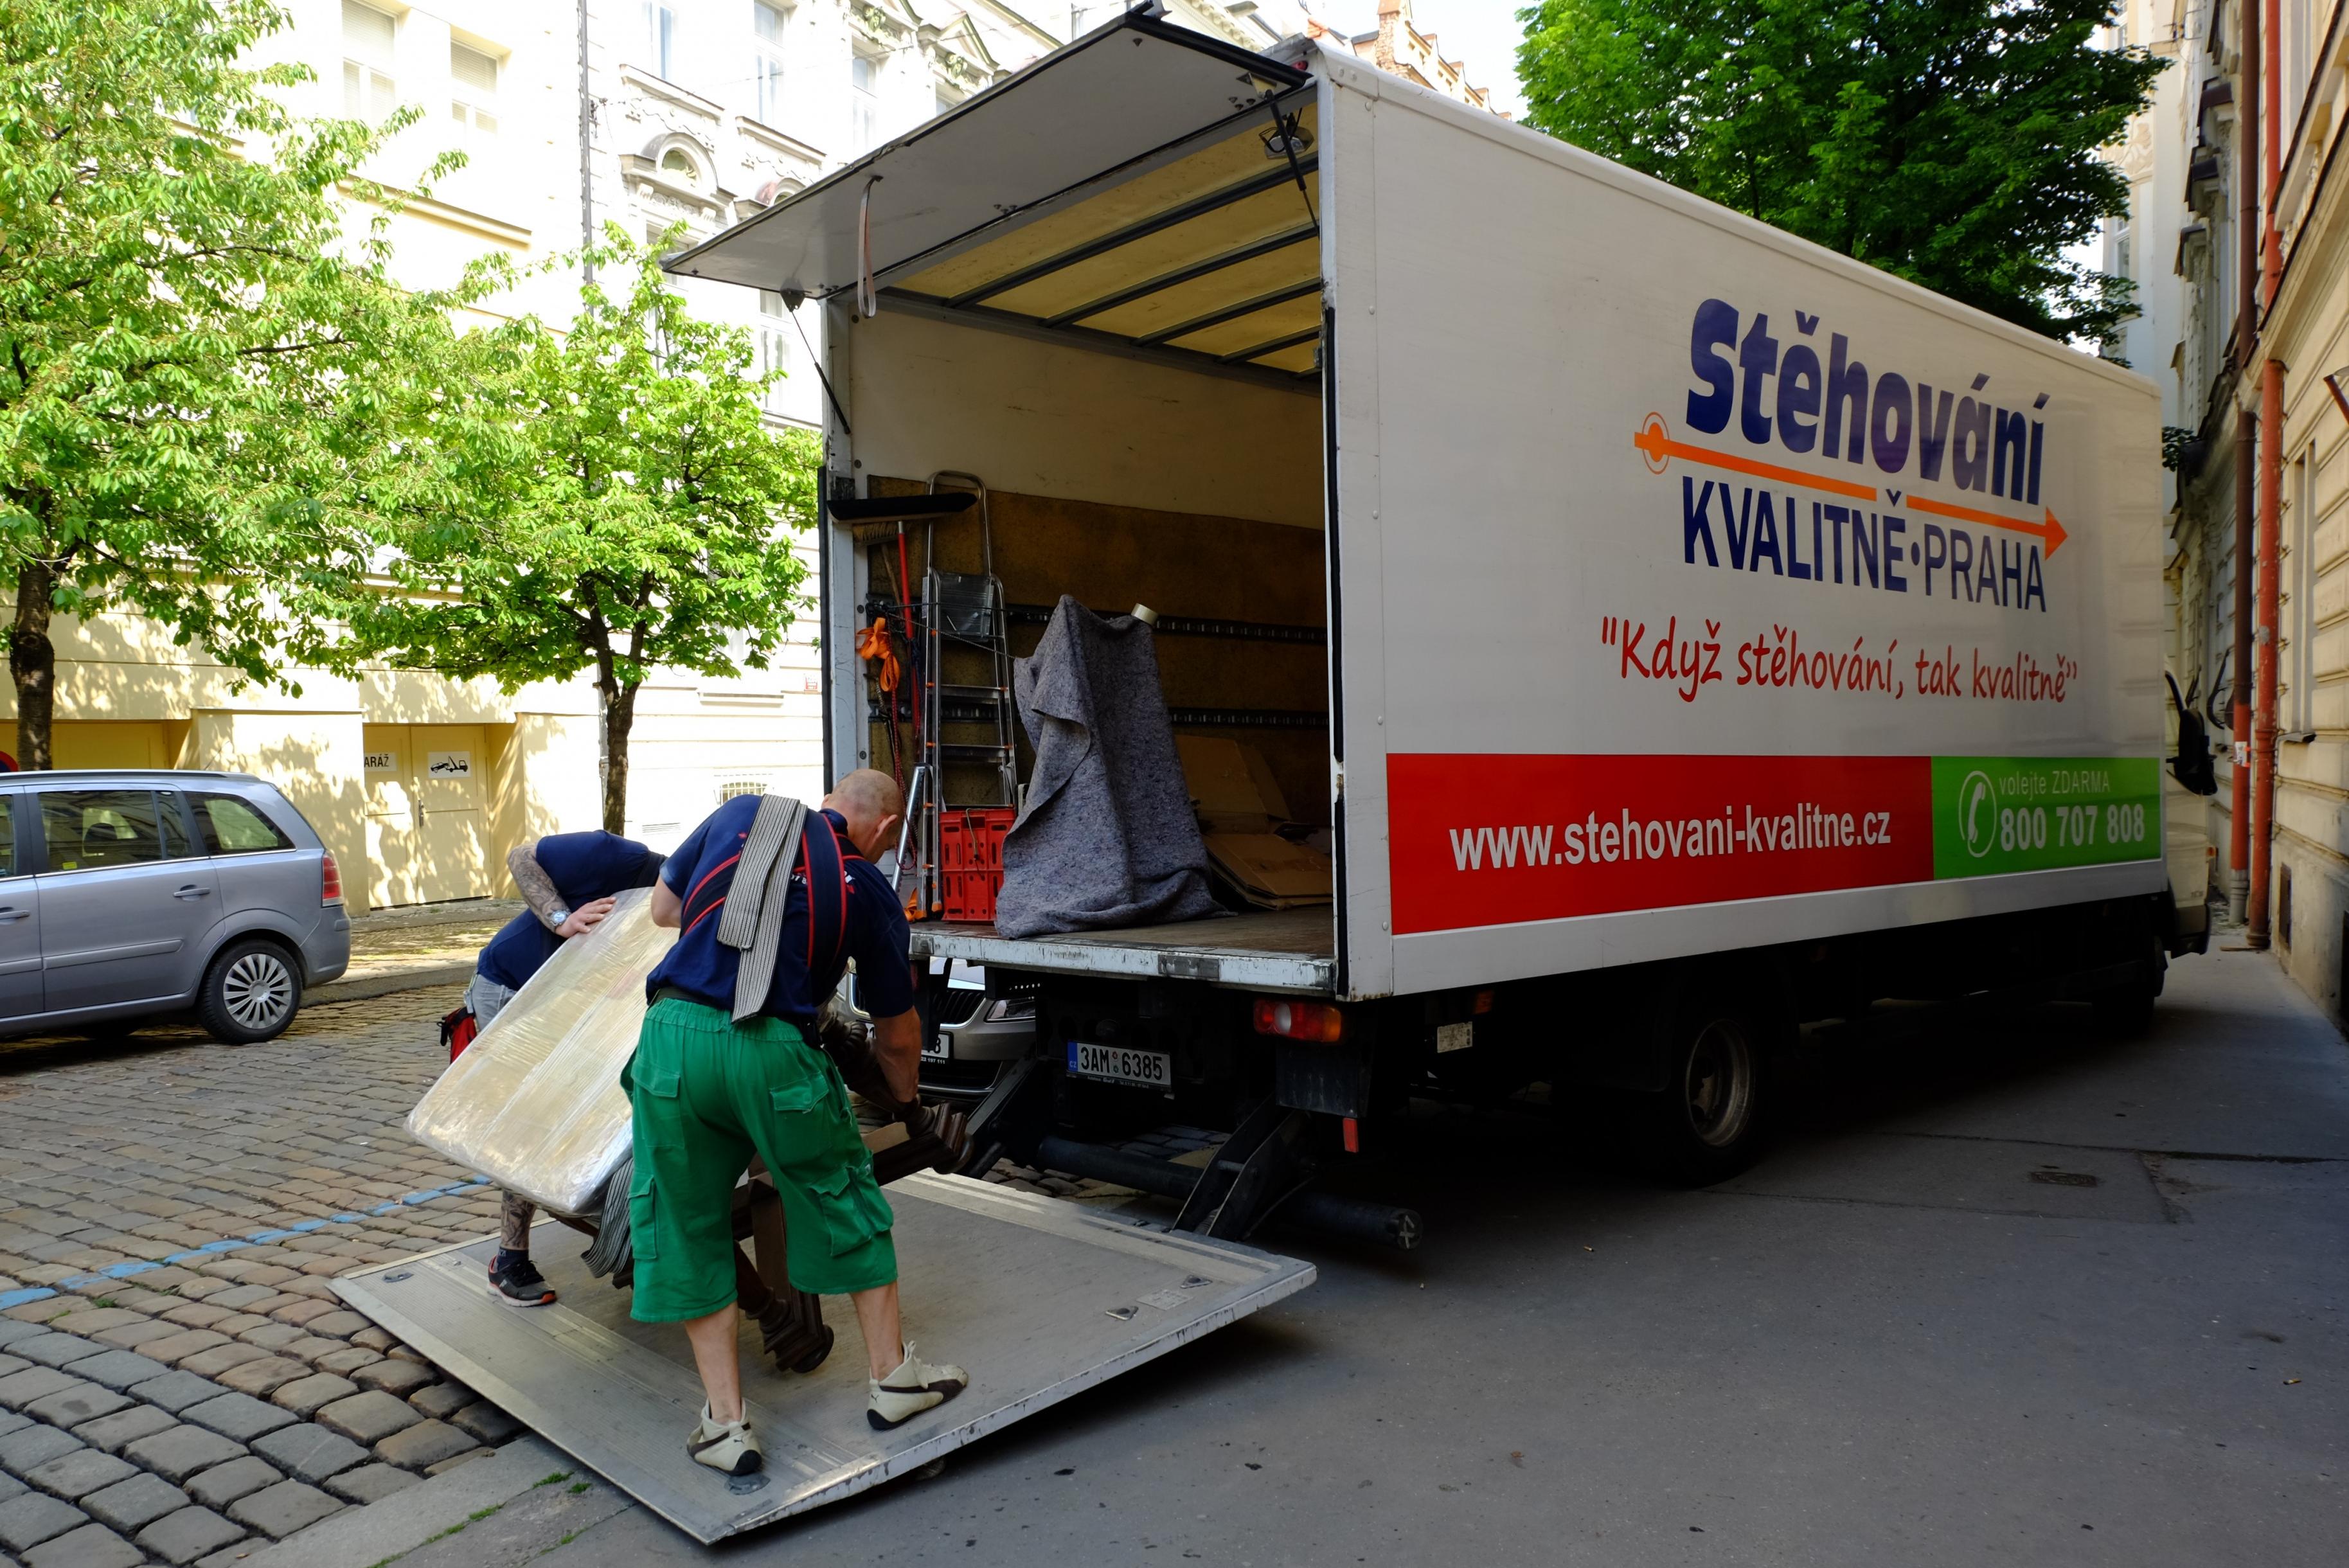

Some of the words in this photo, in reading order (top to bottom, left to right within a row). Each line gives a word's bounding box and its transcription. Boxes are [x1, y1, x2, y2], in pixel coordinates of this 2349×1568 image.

[1686, 298, 2050, 507] Stěhování
[1736, 623, 1904, 700] stěhování,
[1914, 647, 1962, 697] tak
[364, 753, 389, 768] ARÁŽ
[1999, 771, 2046, 801] volejte
[2051, 771, 2111, 795] ZDARMA
[1449, 803, 1891, 871] www.stehovani-kvalitne.cz
[2000, 806, 2047, 851] 800
[2056, 805, 2099, 848] 707
[2107, 803, 2145, 844] 808
[1080, 1046, 1110, 1073] 3AM
[1121, 1052, 1163, 1081] 6385
